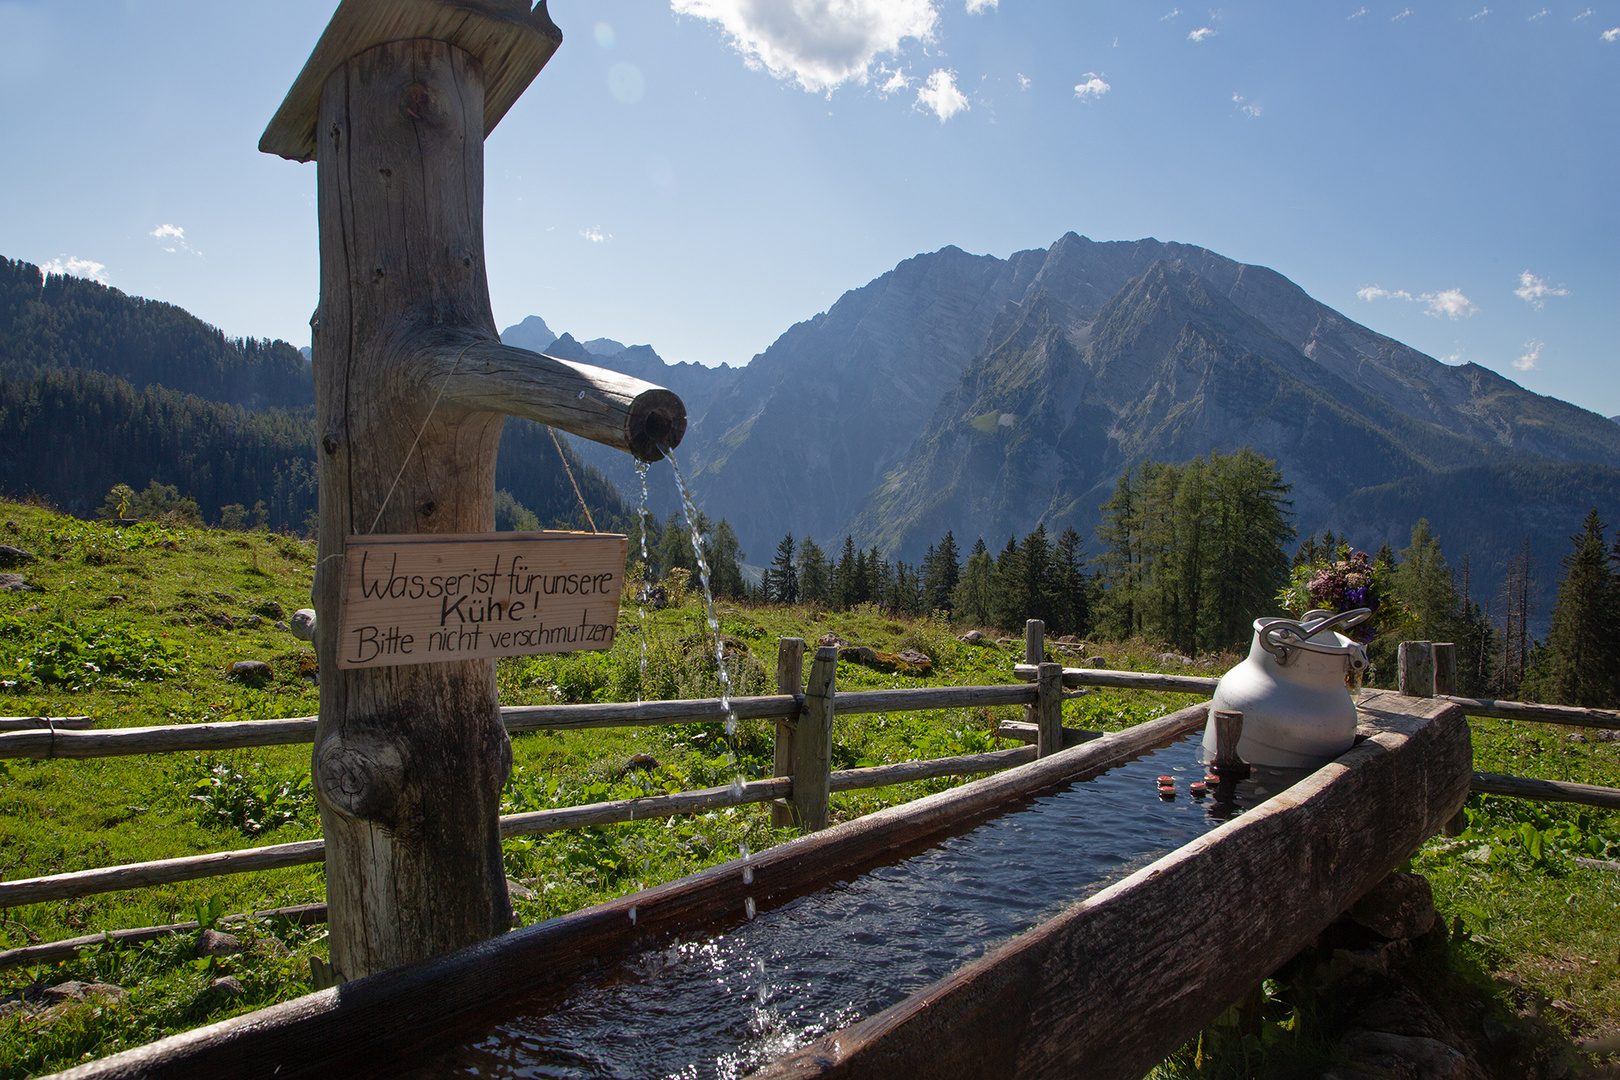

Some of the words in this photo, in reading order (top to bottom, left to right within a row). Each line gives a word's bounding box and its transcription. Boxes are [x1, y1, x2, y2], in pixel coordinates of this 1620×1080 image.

[361, 551, 470, 600] Wasser
[471, 554, 502, 595] ist
[508, 556, 541, 595] für
[543, 572, 613, 595] unsere
[440, 592, 539, 626] Kühe!
[347, 626, 414, 663] Bitte
[428, 624, 483, 651] nicht
[489, 609, 614, 648] verschmutzen
